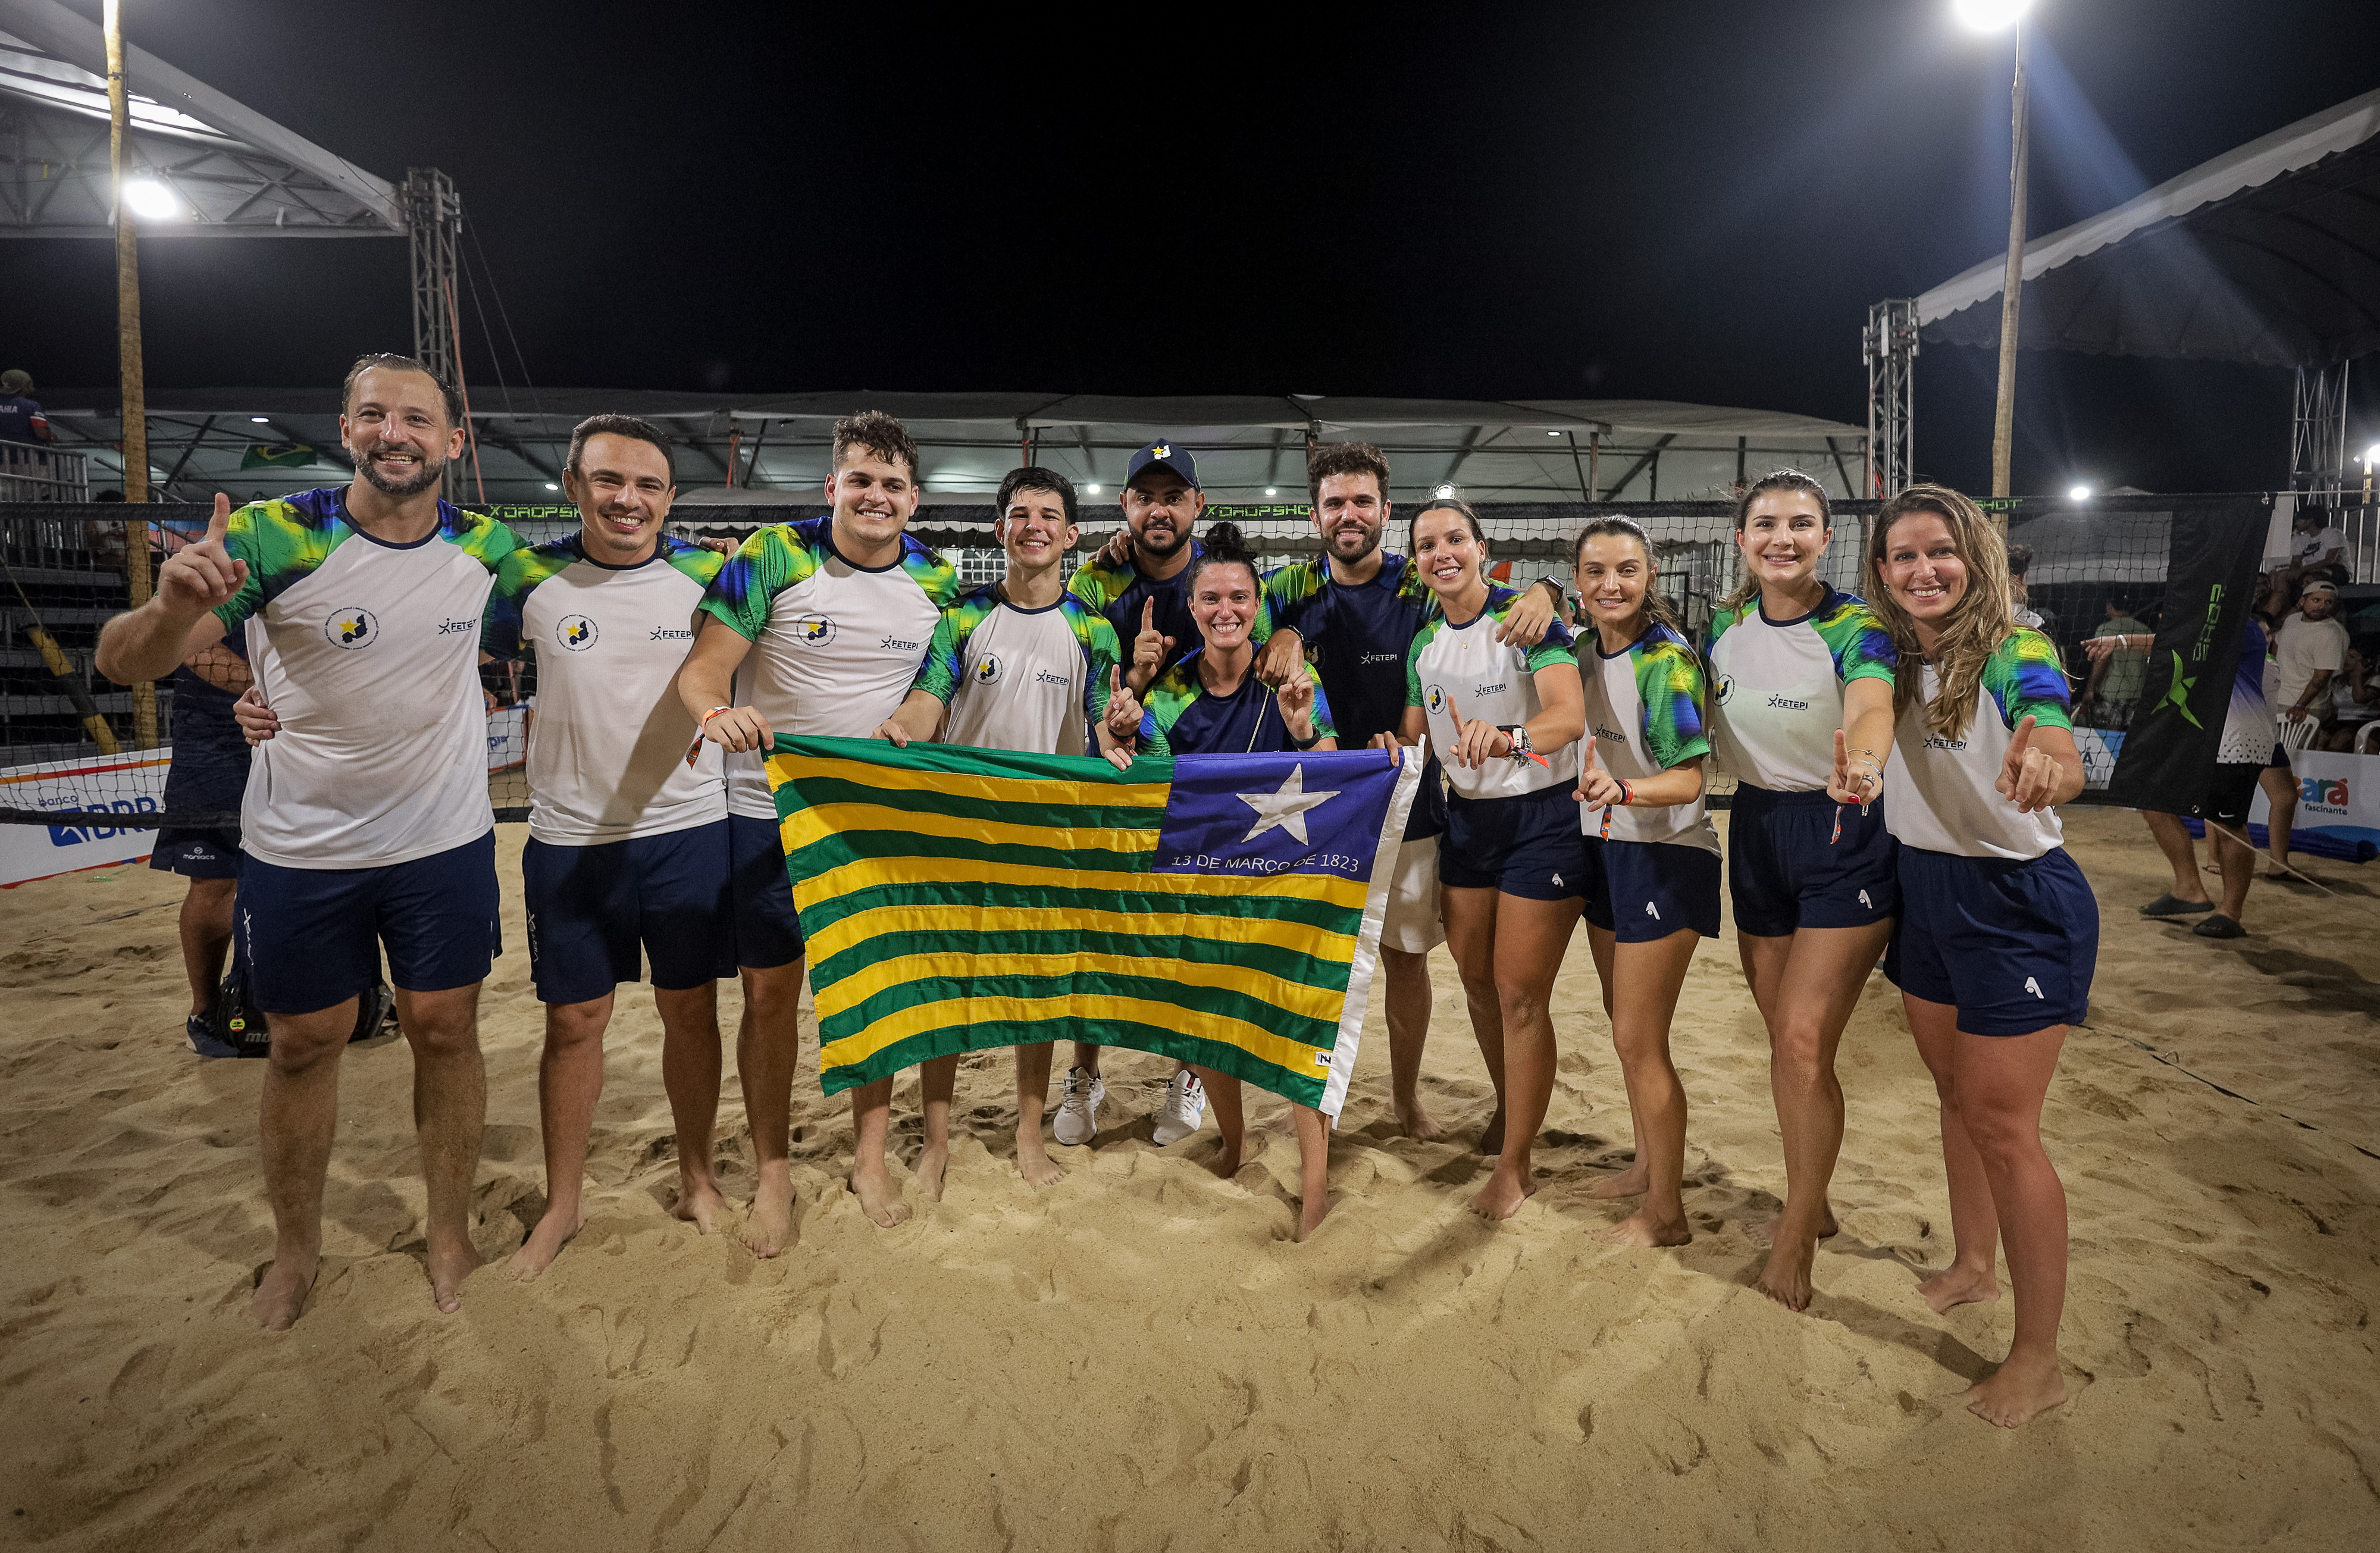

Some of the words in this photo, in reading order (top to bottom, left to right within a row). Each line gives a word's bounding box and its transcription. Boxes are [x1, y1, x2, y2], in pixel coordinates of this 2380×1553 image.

[1220, 506, 1270, 517] DROP
[1273, 505, 1313, 516] SHO
[892, 640, 919, 650] FETEPI
[1045, 674, 1070, 684] FETEPI
[1483, 683, 1507, 693] FETEPI
[1778, 699, 1809, 709] FETEPI
[1601, 728, 1626, 742] FETEPI
[1934, 738, 1967, 749] FETEPI
[37, 795, 78, 807] banco
[2304, 803, 2348, 815] fascinante
[1172, 855, 1191, 866] 13
[1196, 854, 1222, 869] DE
[1225, 857, 1291, 874] MARÇO
[1294, 854, 1317, 867] DE
[1320, 854, 1359, 872] 1823
